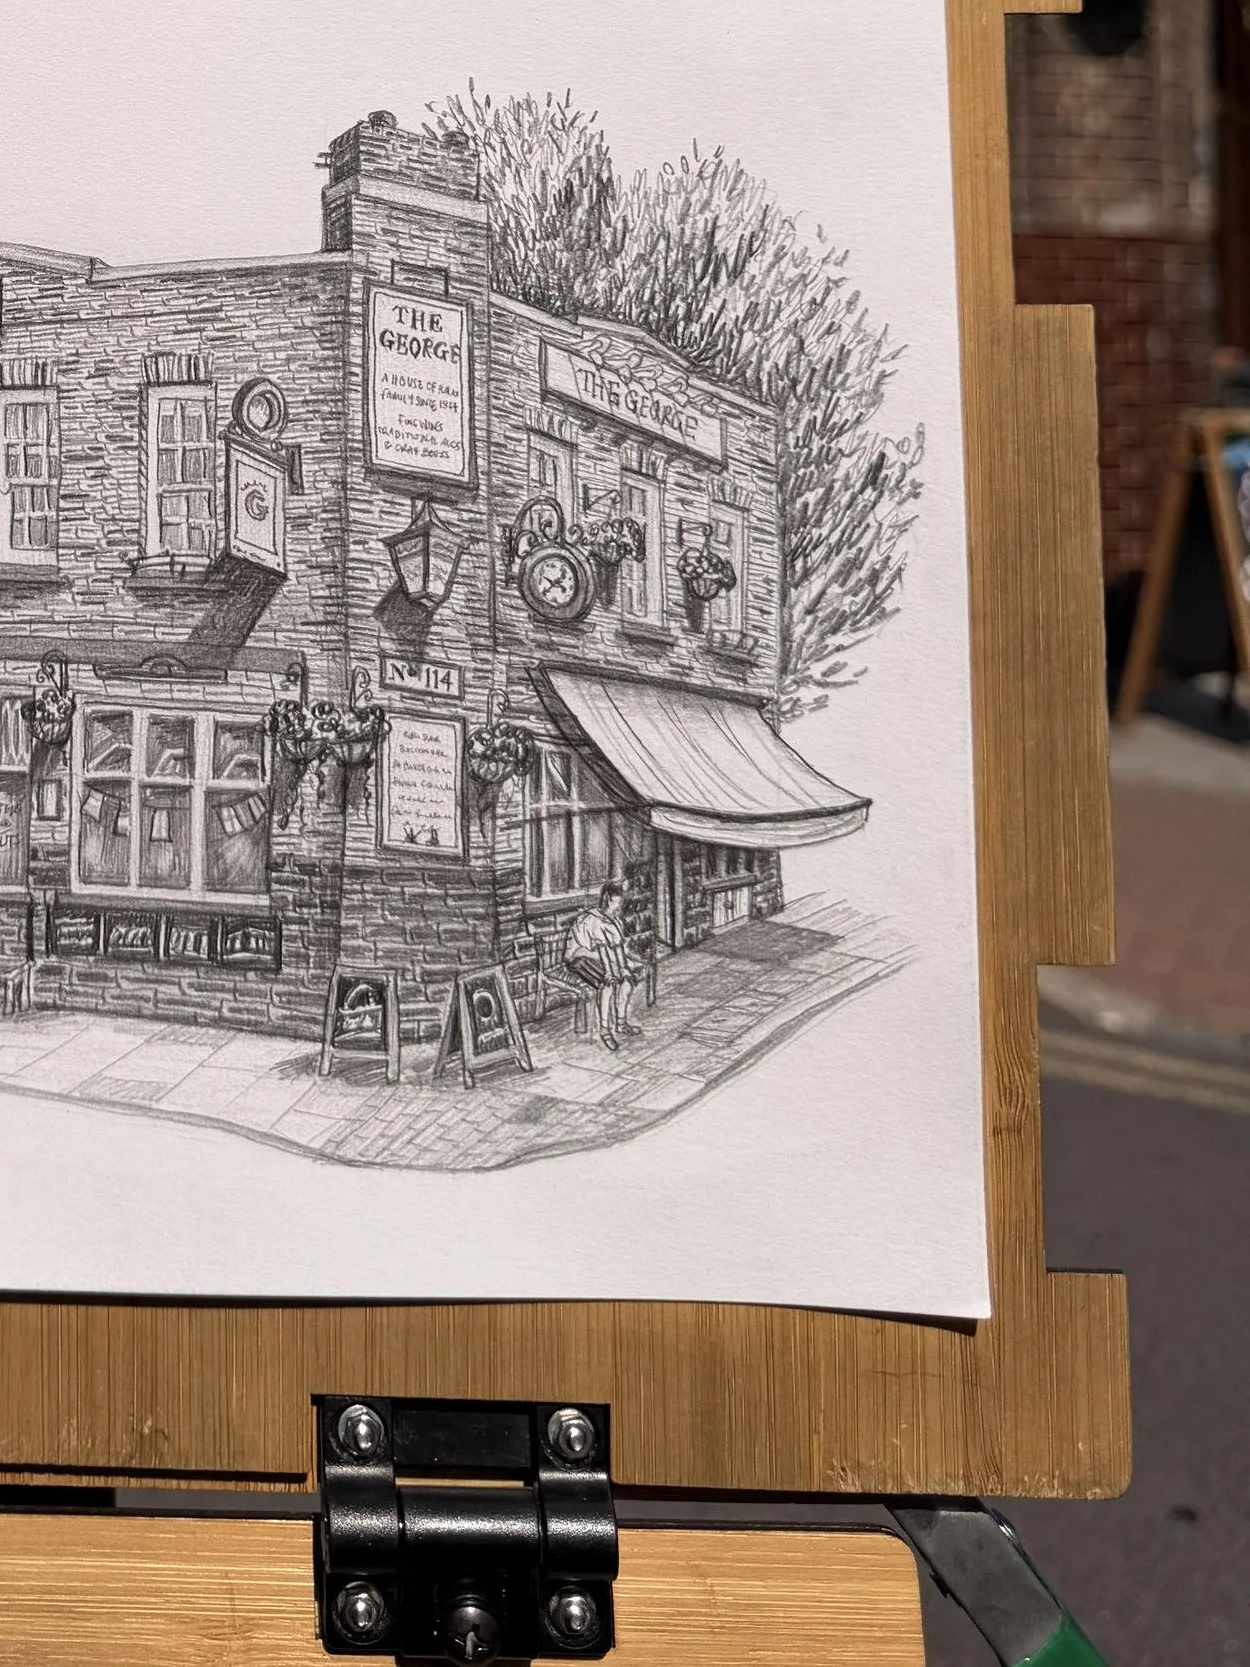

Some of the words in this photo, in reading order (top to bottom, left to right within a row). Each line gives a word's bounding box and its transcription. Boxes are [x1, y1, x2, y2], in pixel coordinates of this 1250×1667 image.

[392, 305, 443, 332] THE
[379, 328, 461, 364] GEORGE
[577, 368, 621, 406] THE
[624, 389, 699, 441] GEORGE
[425, 666, 454, 692] 114
